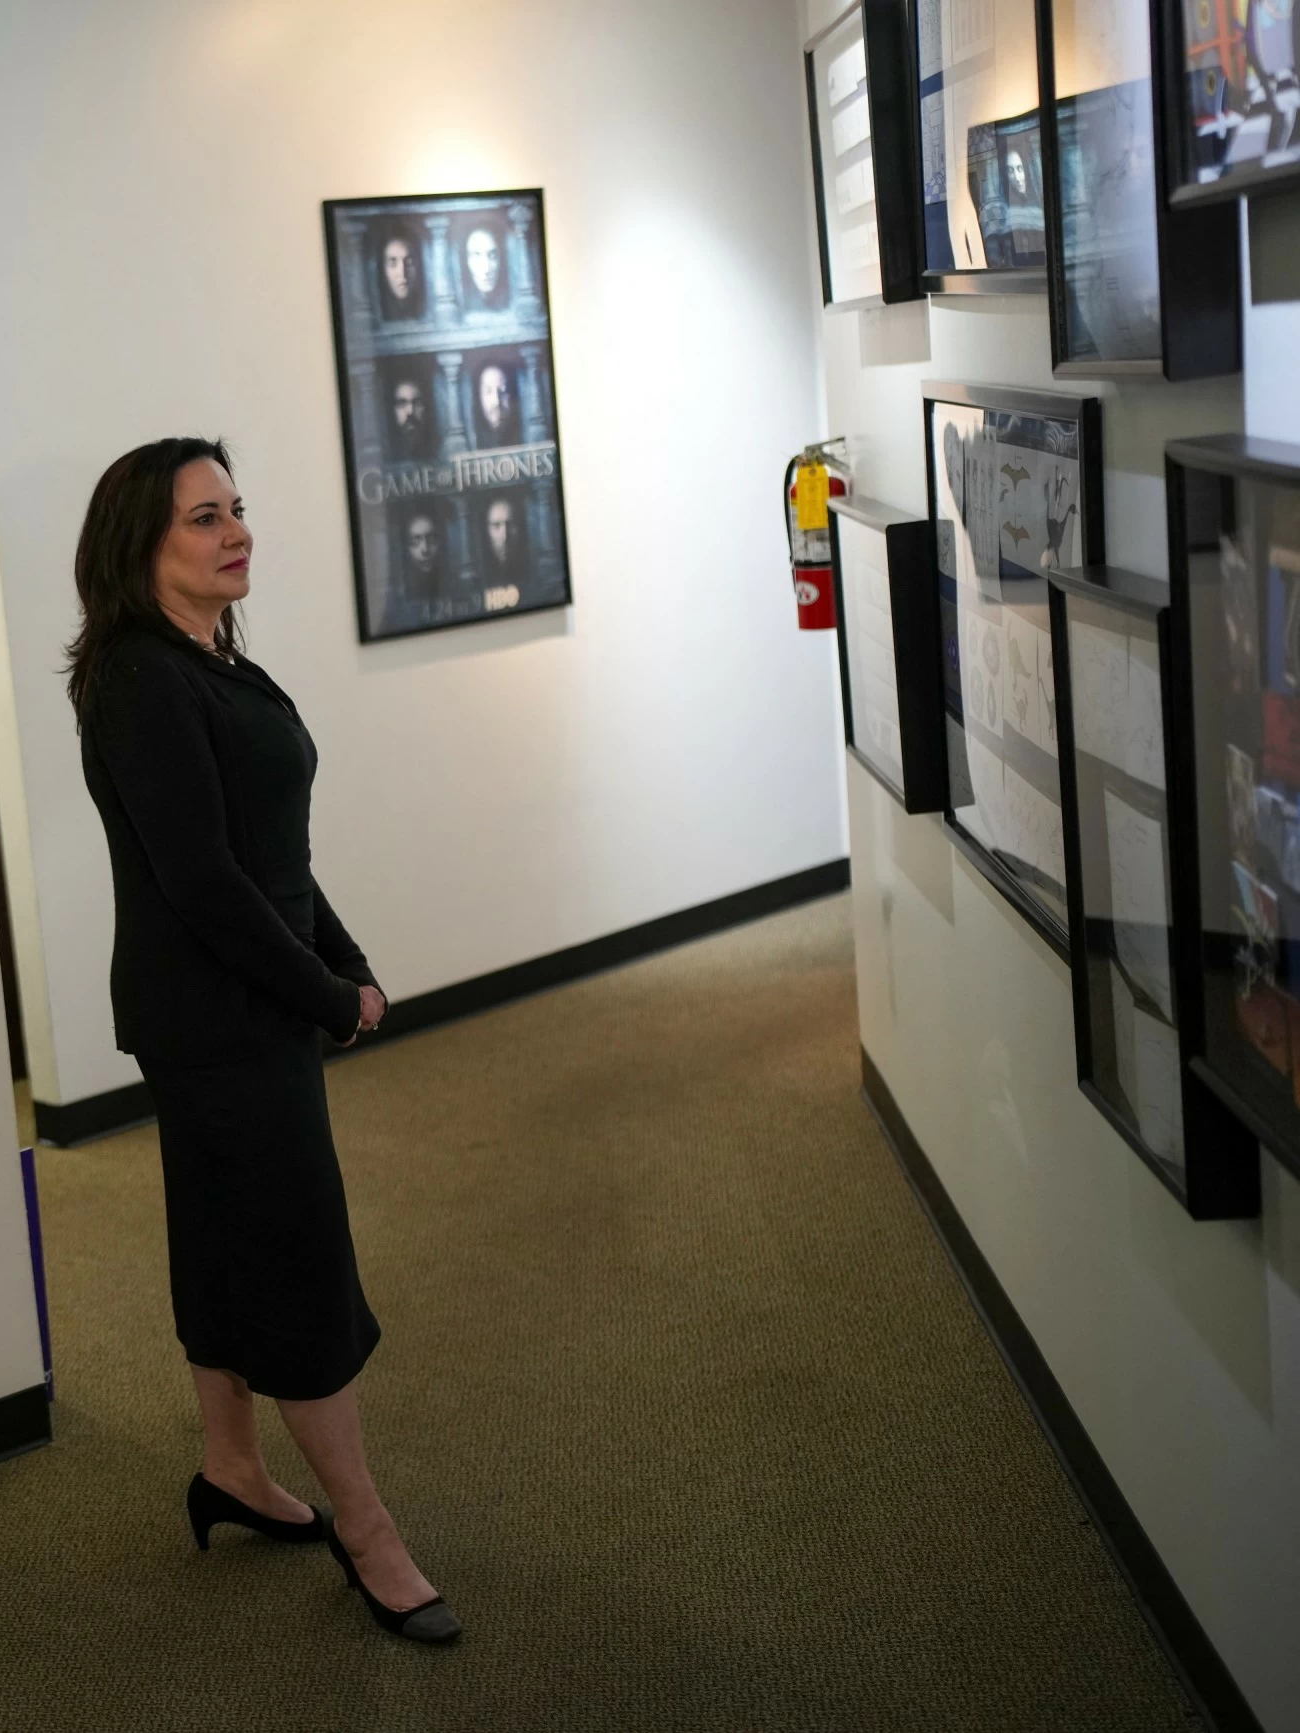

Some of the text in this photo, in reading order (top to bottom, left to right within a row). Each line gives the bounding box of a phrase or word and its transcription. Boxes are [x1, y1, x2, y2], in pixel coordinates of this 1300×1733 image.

[360, 466, 435, 504] GAME
[452, 442, 556, 491] THRONES
[485, 585, 520, 611] HBO
